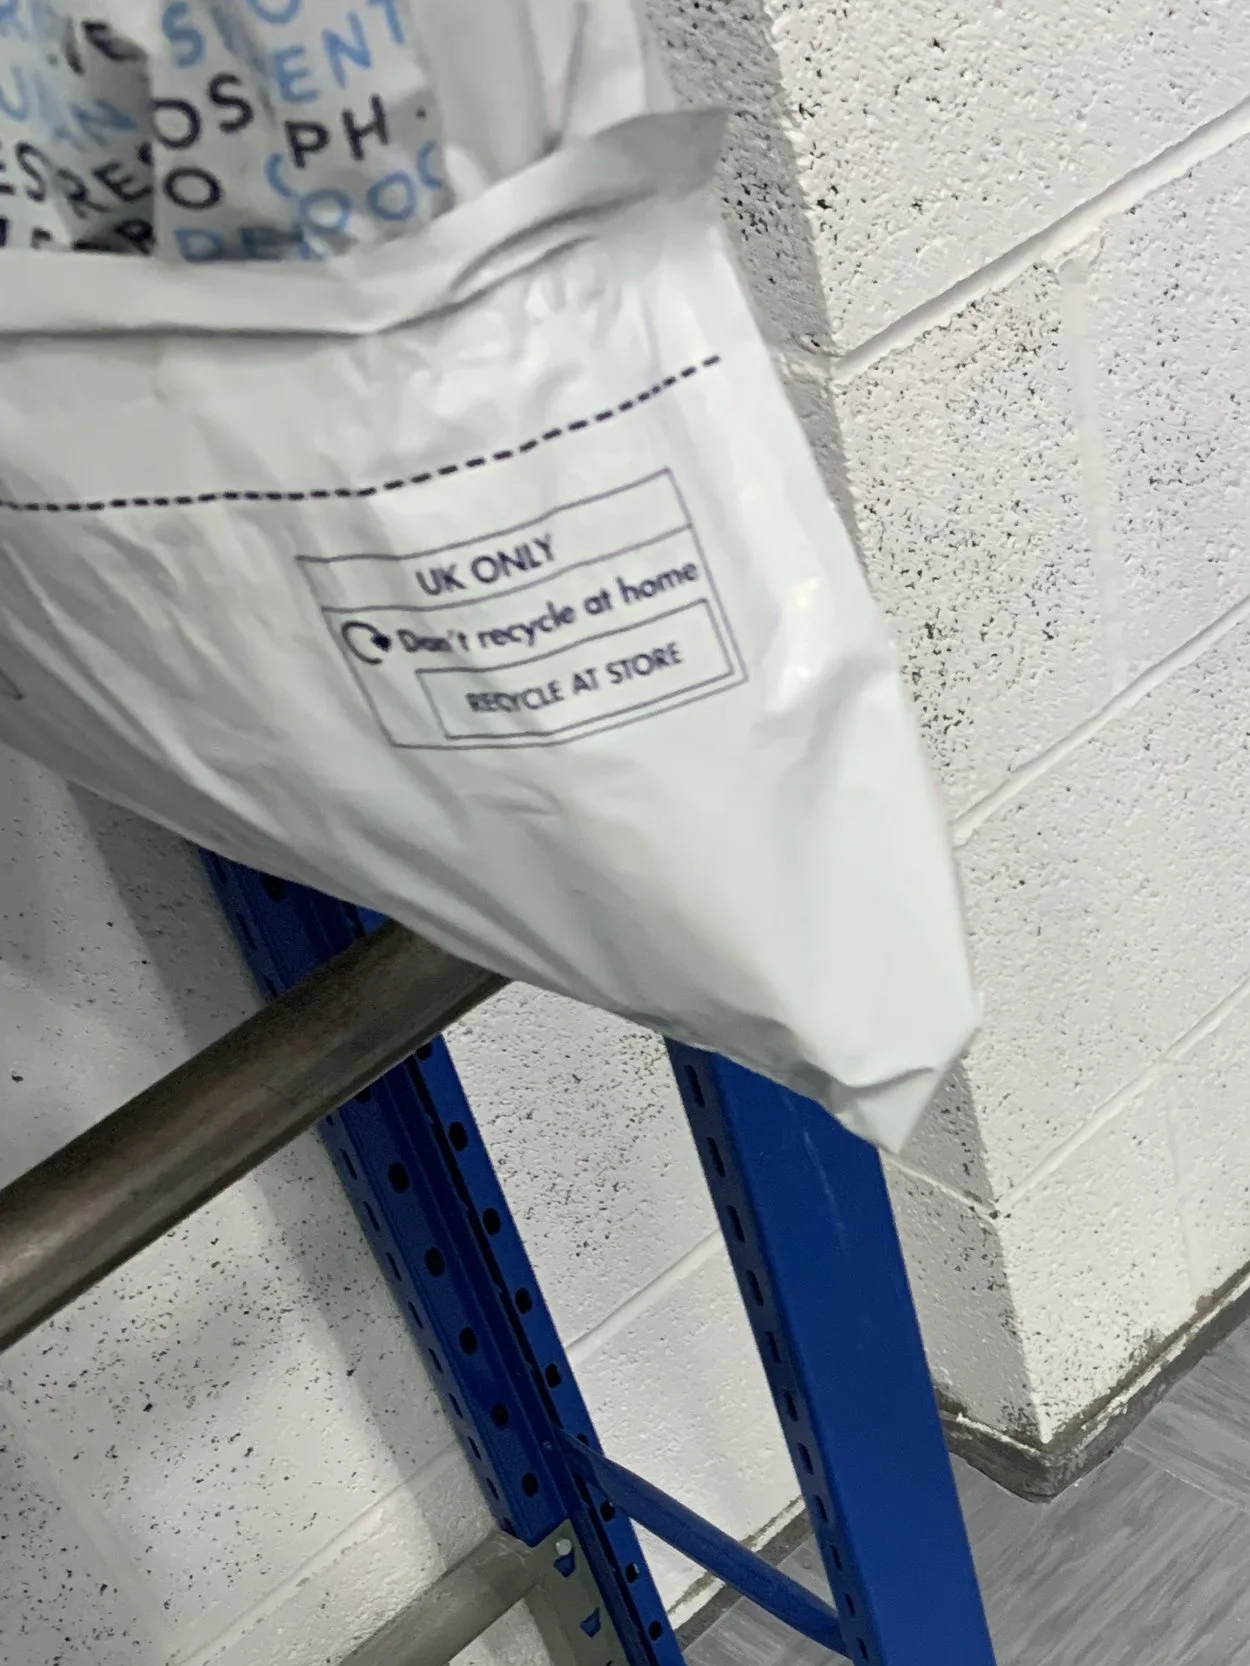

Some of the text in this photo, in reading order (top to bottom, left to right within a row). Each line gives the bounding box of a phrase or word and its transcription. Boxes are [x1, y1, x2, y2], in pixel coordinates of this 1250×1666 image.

[415, 534, 555, 597] UK ONLY
[396, 563, 699, 655] Don't recycle at home
[464, 642, 682, 714] RECYCLE AT STORE
